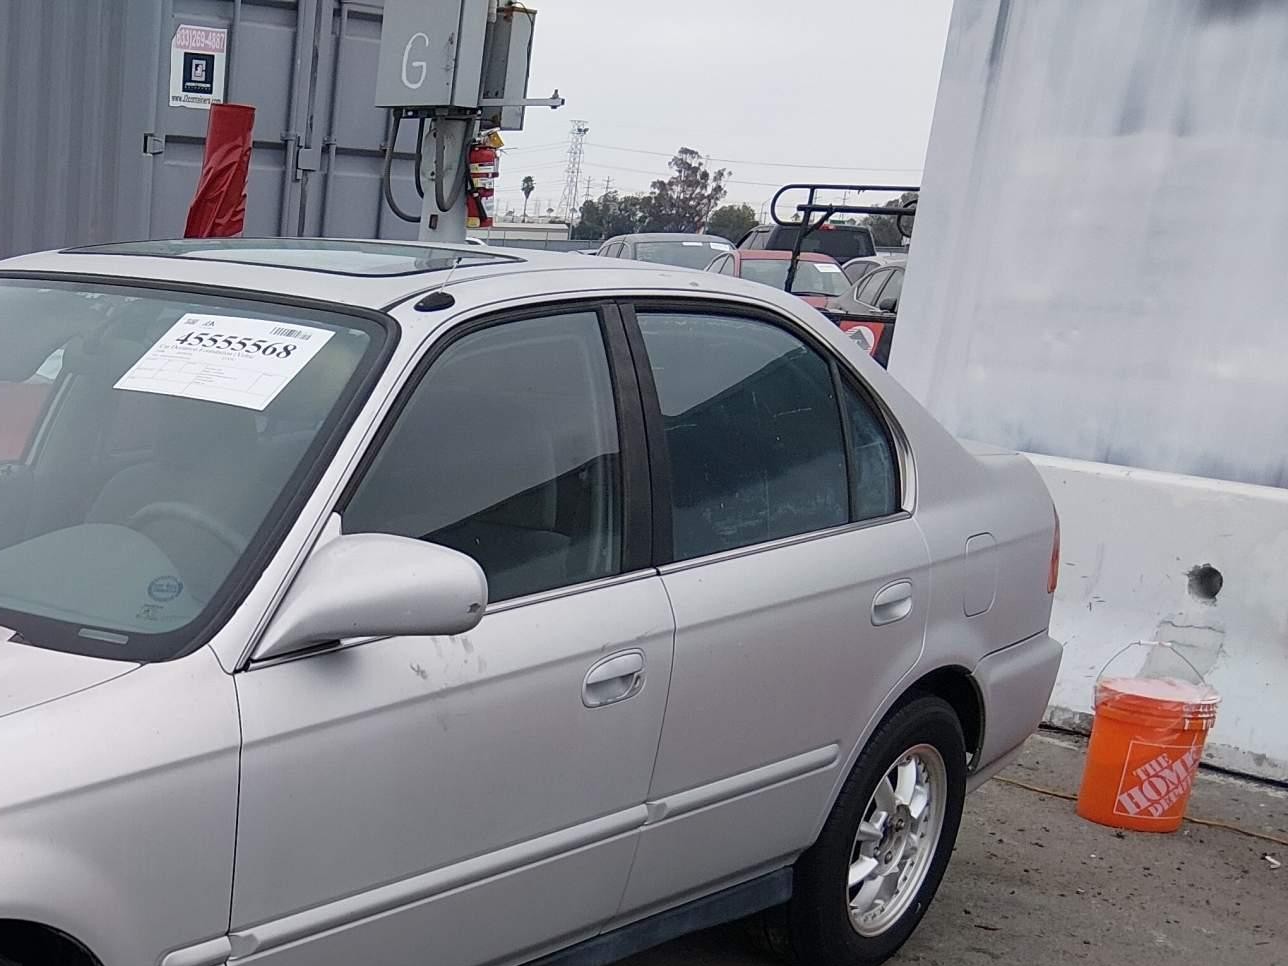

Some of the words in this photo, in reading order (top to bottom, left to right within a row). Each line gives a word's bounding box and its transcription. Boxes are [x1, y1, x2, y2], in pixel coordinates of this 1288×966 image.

[401, 32, 430, 90] G
[175, 331, 298, 359] 45555568
[1132, 753, 1172, 780] THE
